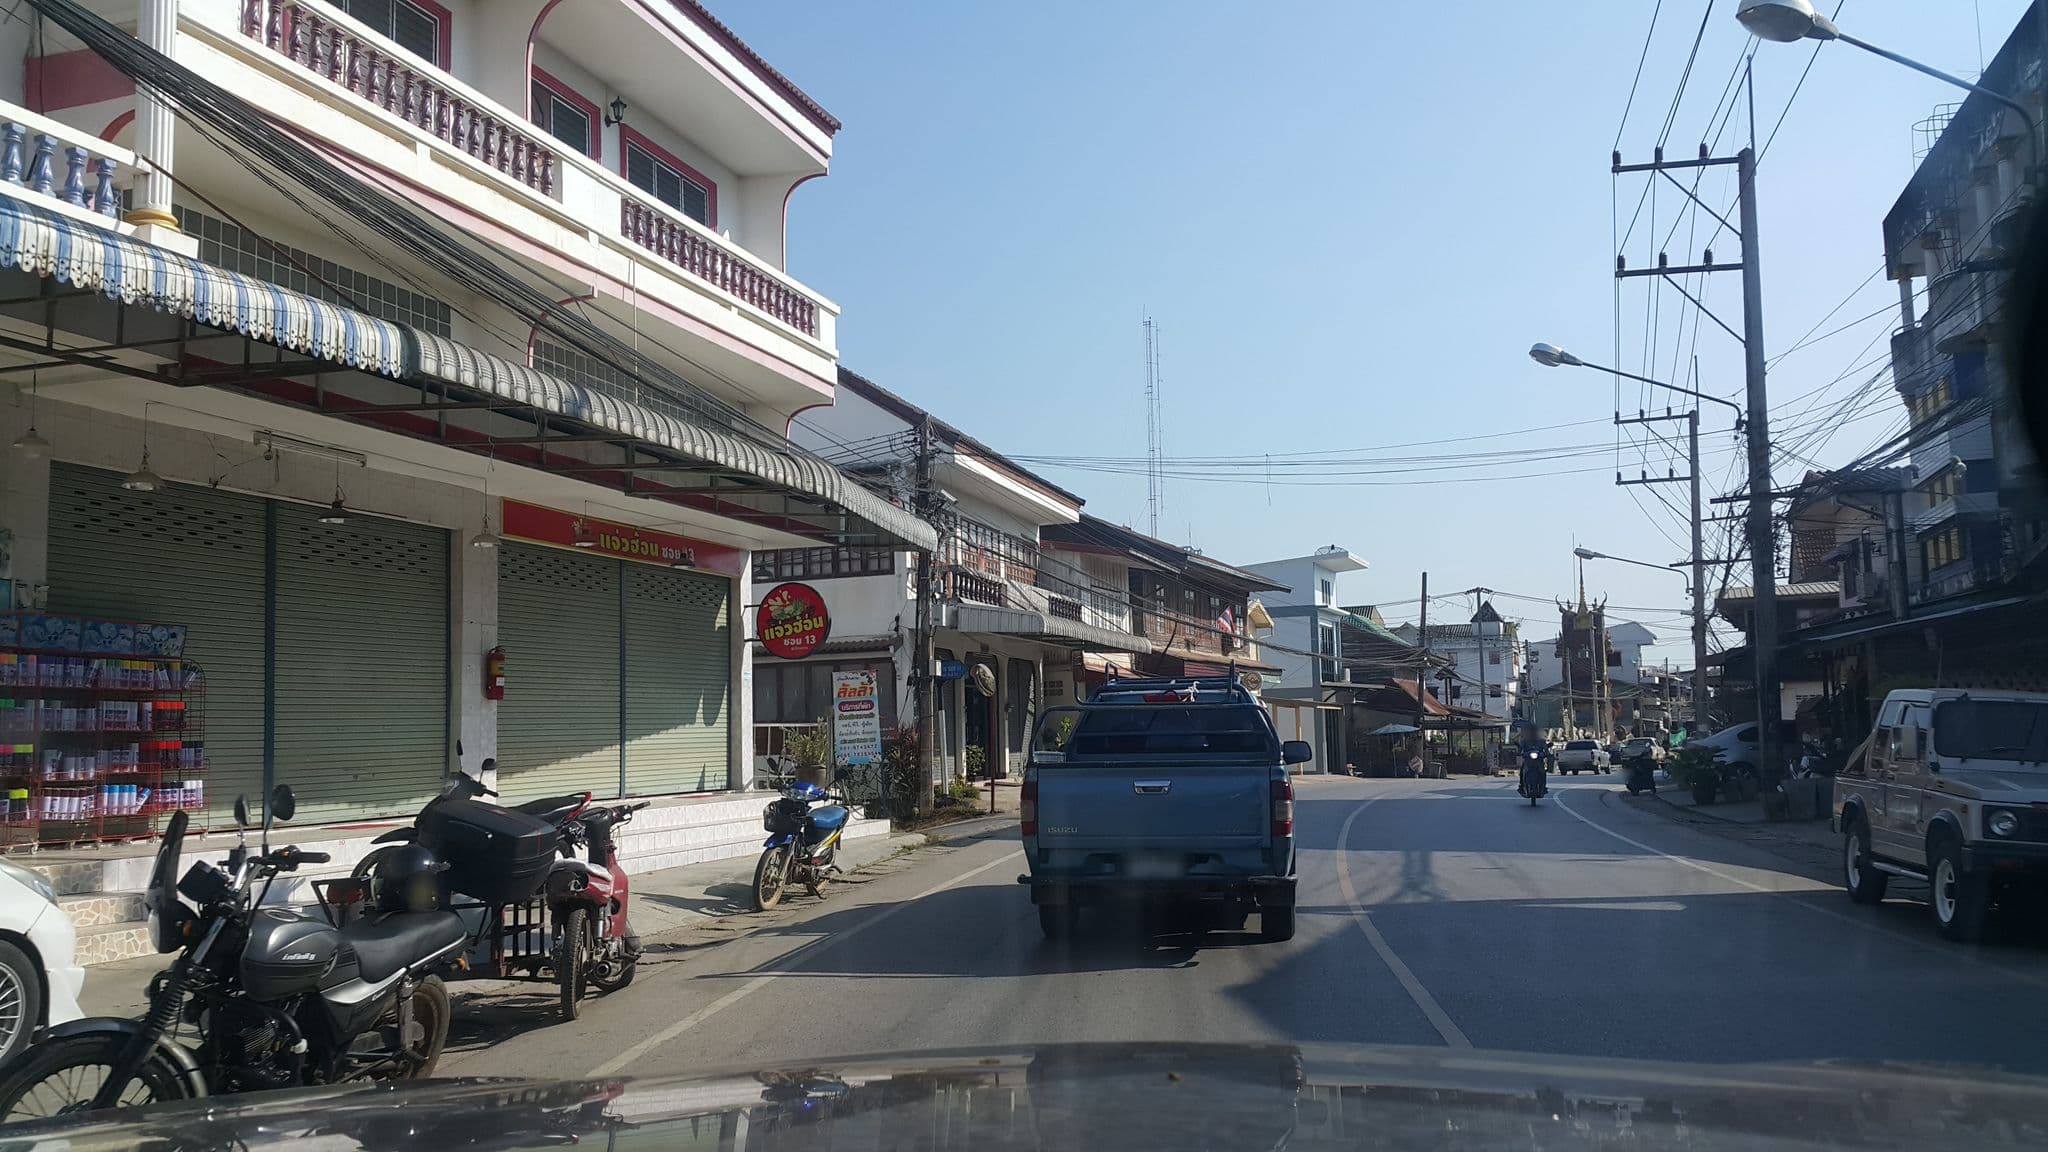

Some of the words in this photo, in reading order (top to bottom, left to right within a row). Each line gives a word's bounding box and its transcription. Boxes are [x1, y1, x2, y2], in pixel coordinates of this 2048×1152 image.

[661, 547, 681, 559] ซอย
[783, 637, 802, 646] ซอย
[804, 634, 817, 645] 13
